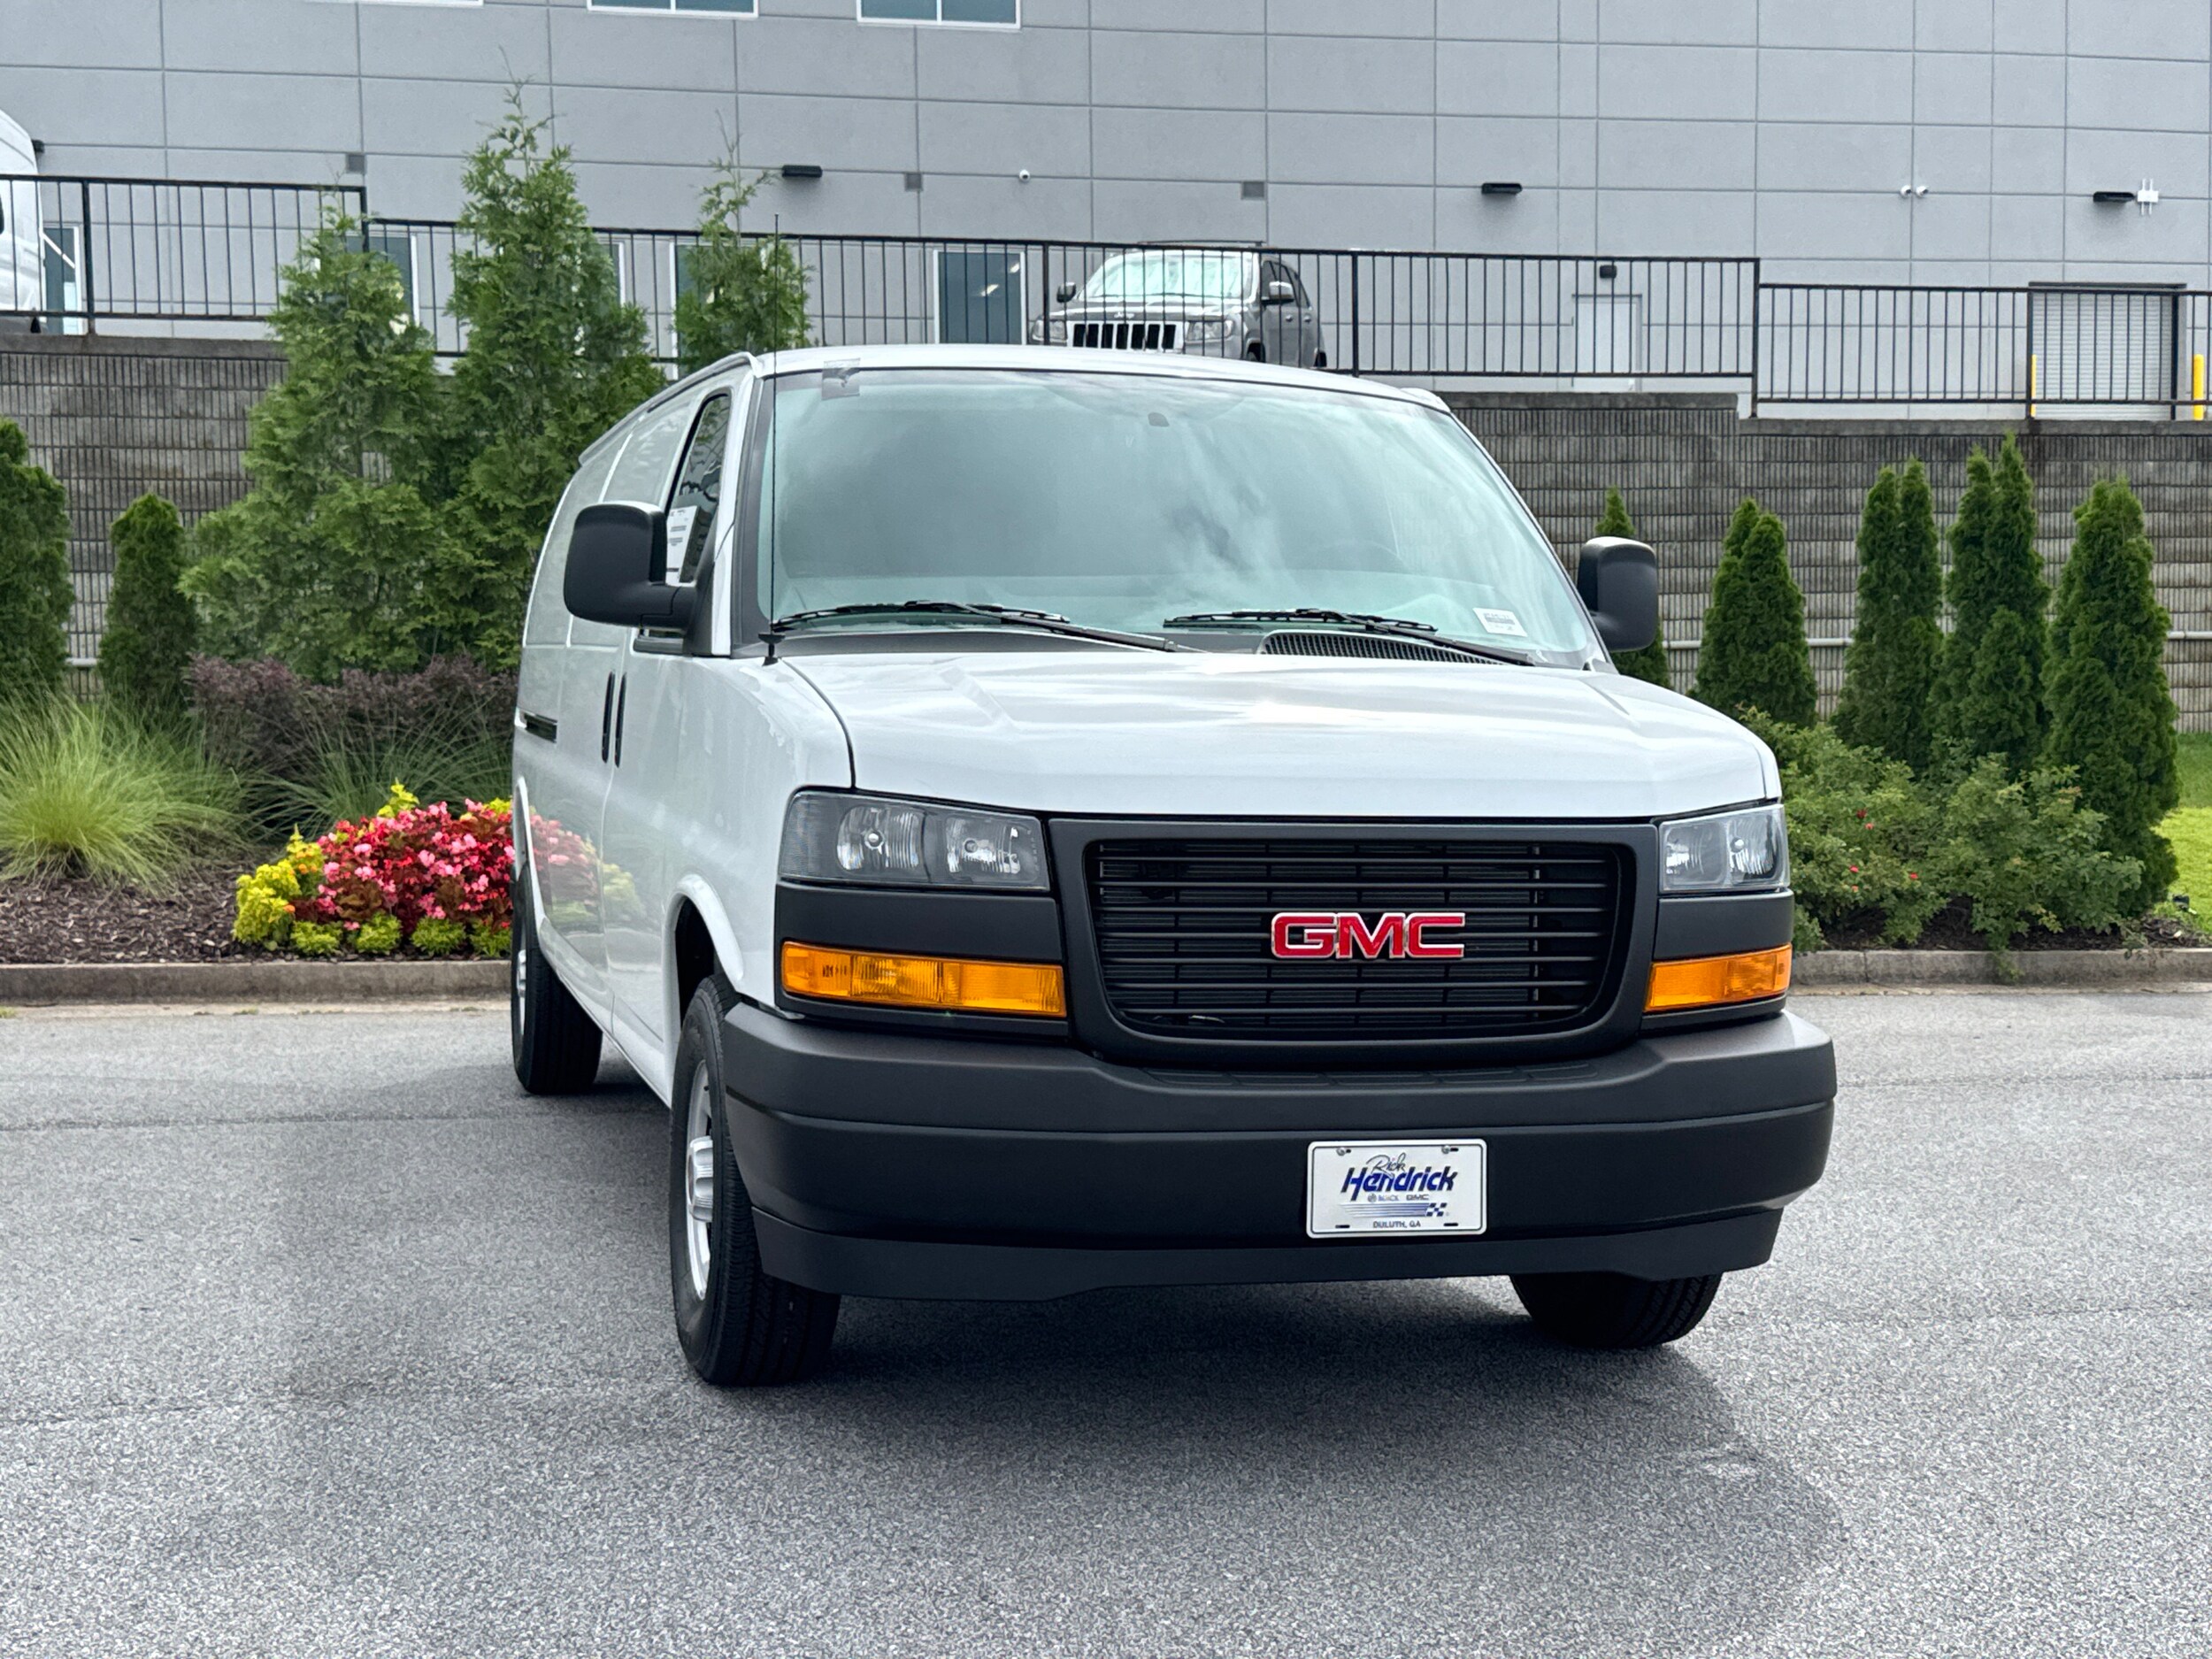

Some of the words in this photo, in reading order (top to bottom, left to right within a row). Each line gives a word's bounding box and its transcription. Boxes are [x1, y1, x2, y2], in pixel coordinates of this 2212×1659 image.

[1271, 912, 1465, 958] GMC
[1366, 1152, 1407, 1178] Rick
[1340, 1166, 1458, 1202] Hendrick
[1372, 1220, 1408, 1229] DULUTH,
[1409, 1219, 1421, 1228] GA
